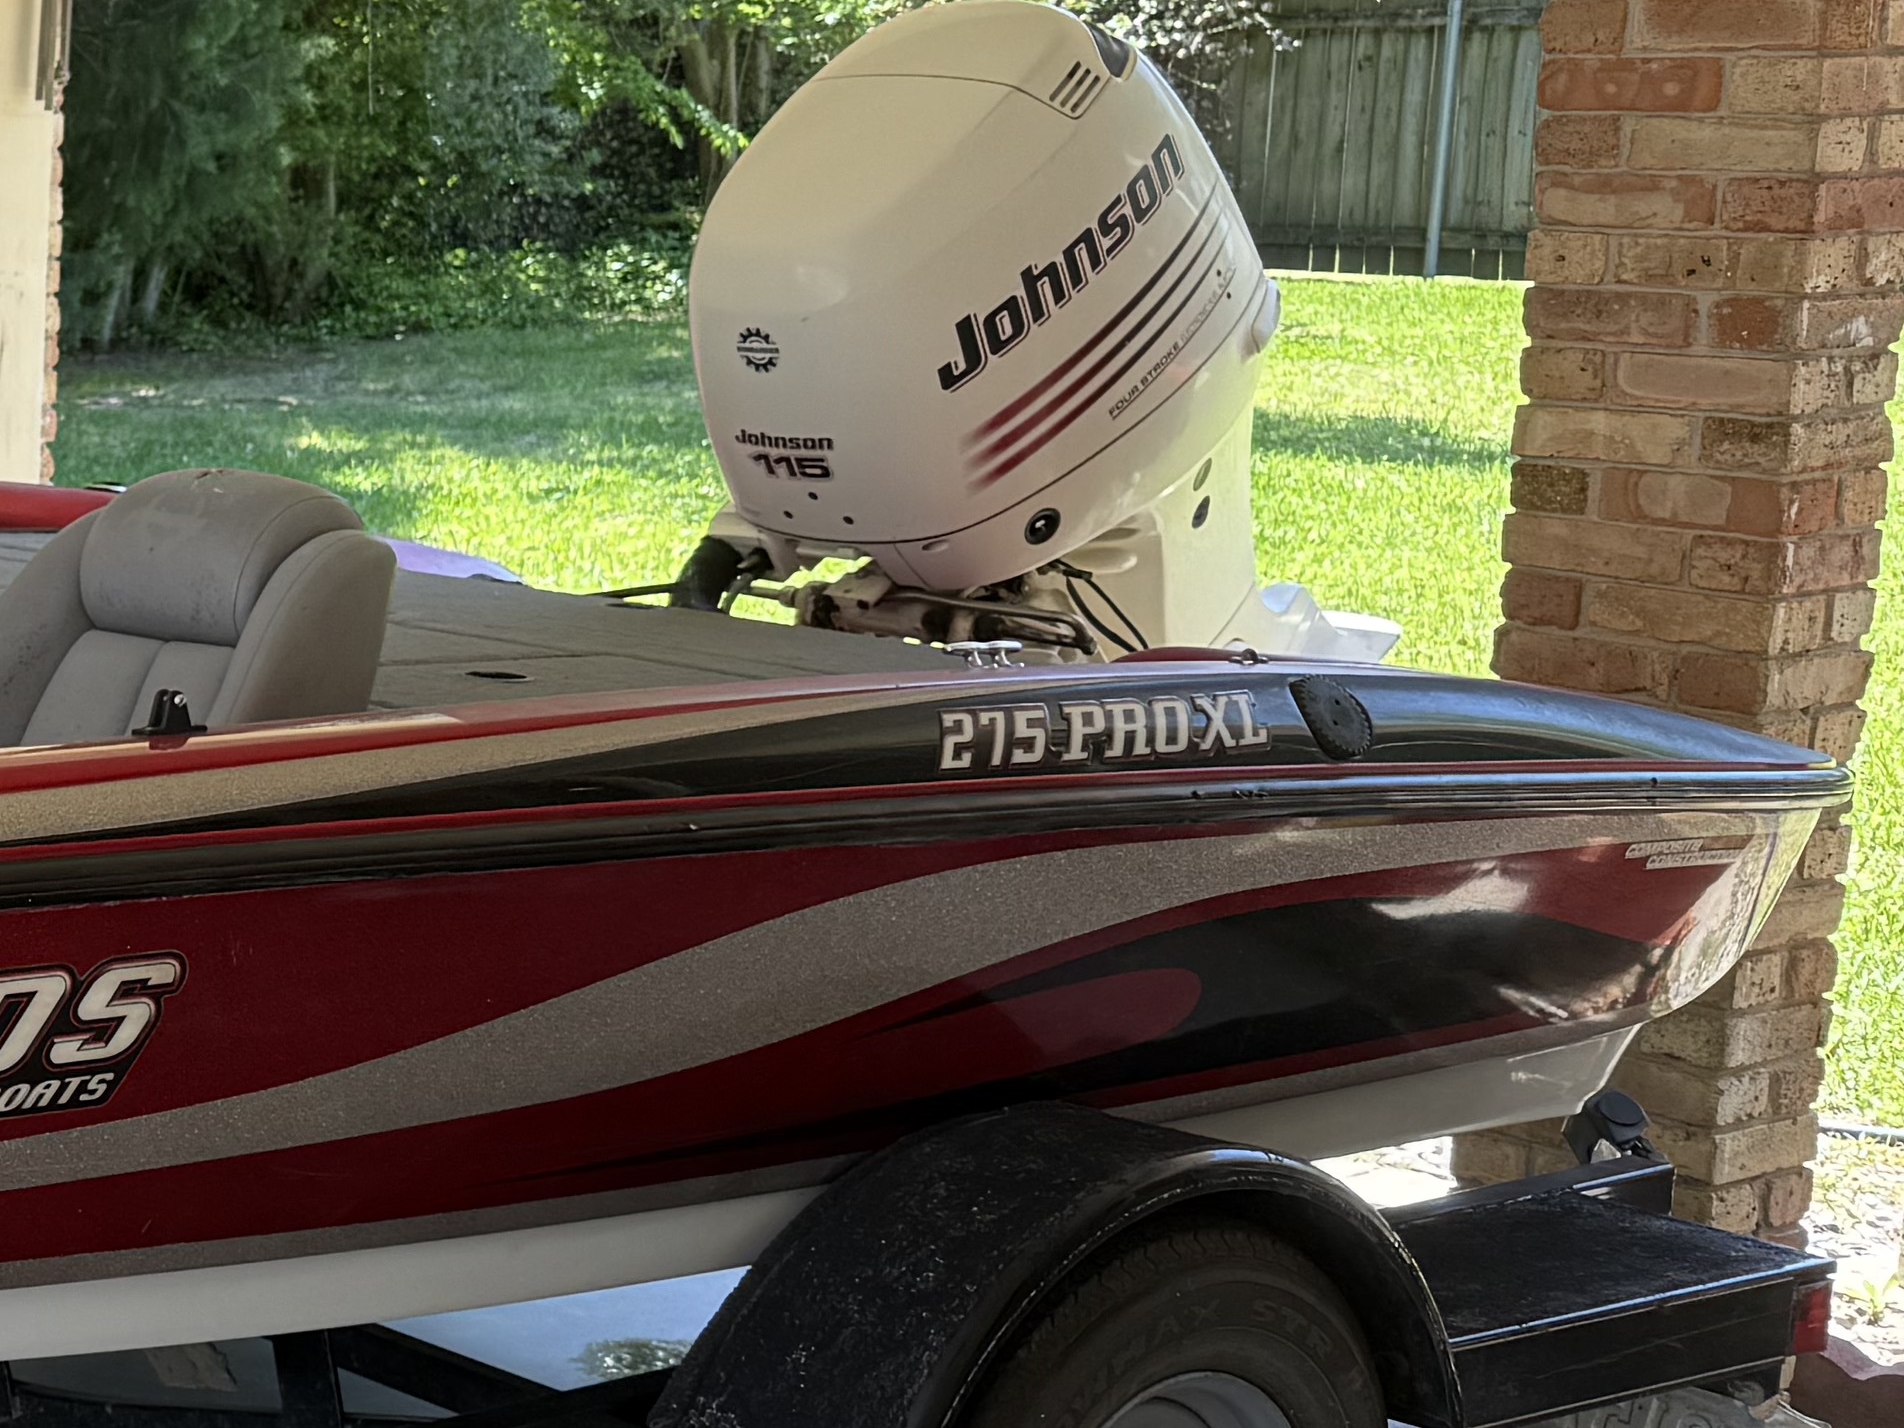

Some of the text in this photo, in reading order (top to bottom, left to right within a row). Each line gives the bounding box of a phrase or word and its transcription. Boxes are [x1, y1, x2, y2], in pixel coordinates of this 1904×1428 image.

[936, 132, 1187, 393] Johnson
[1108, 384, 1141, 417] FOUR
[734, 428, 835, 451] Johnson
[750, 452, 834, 481] 115
[939, 706, 1050, 772] 275
